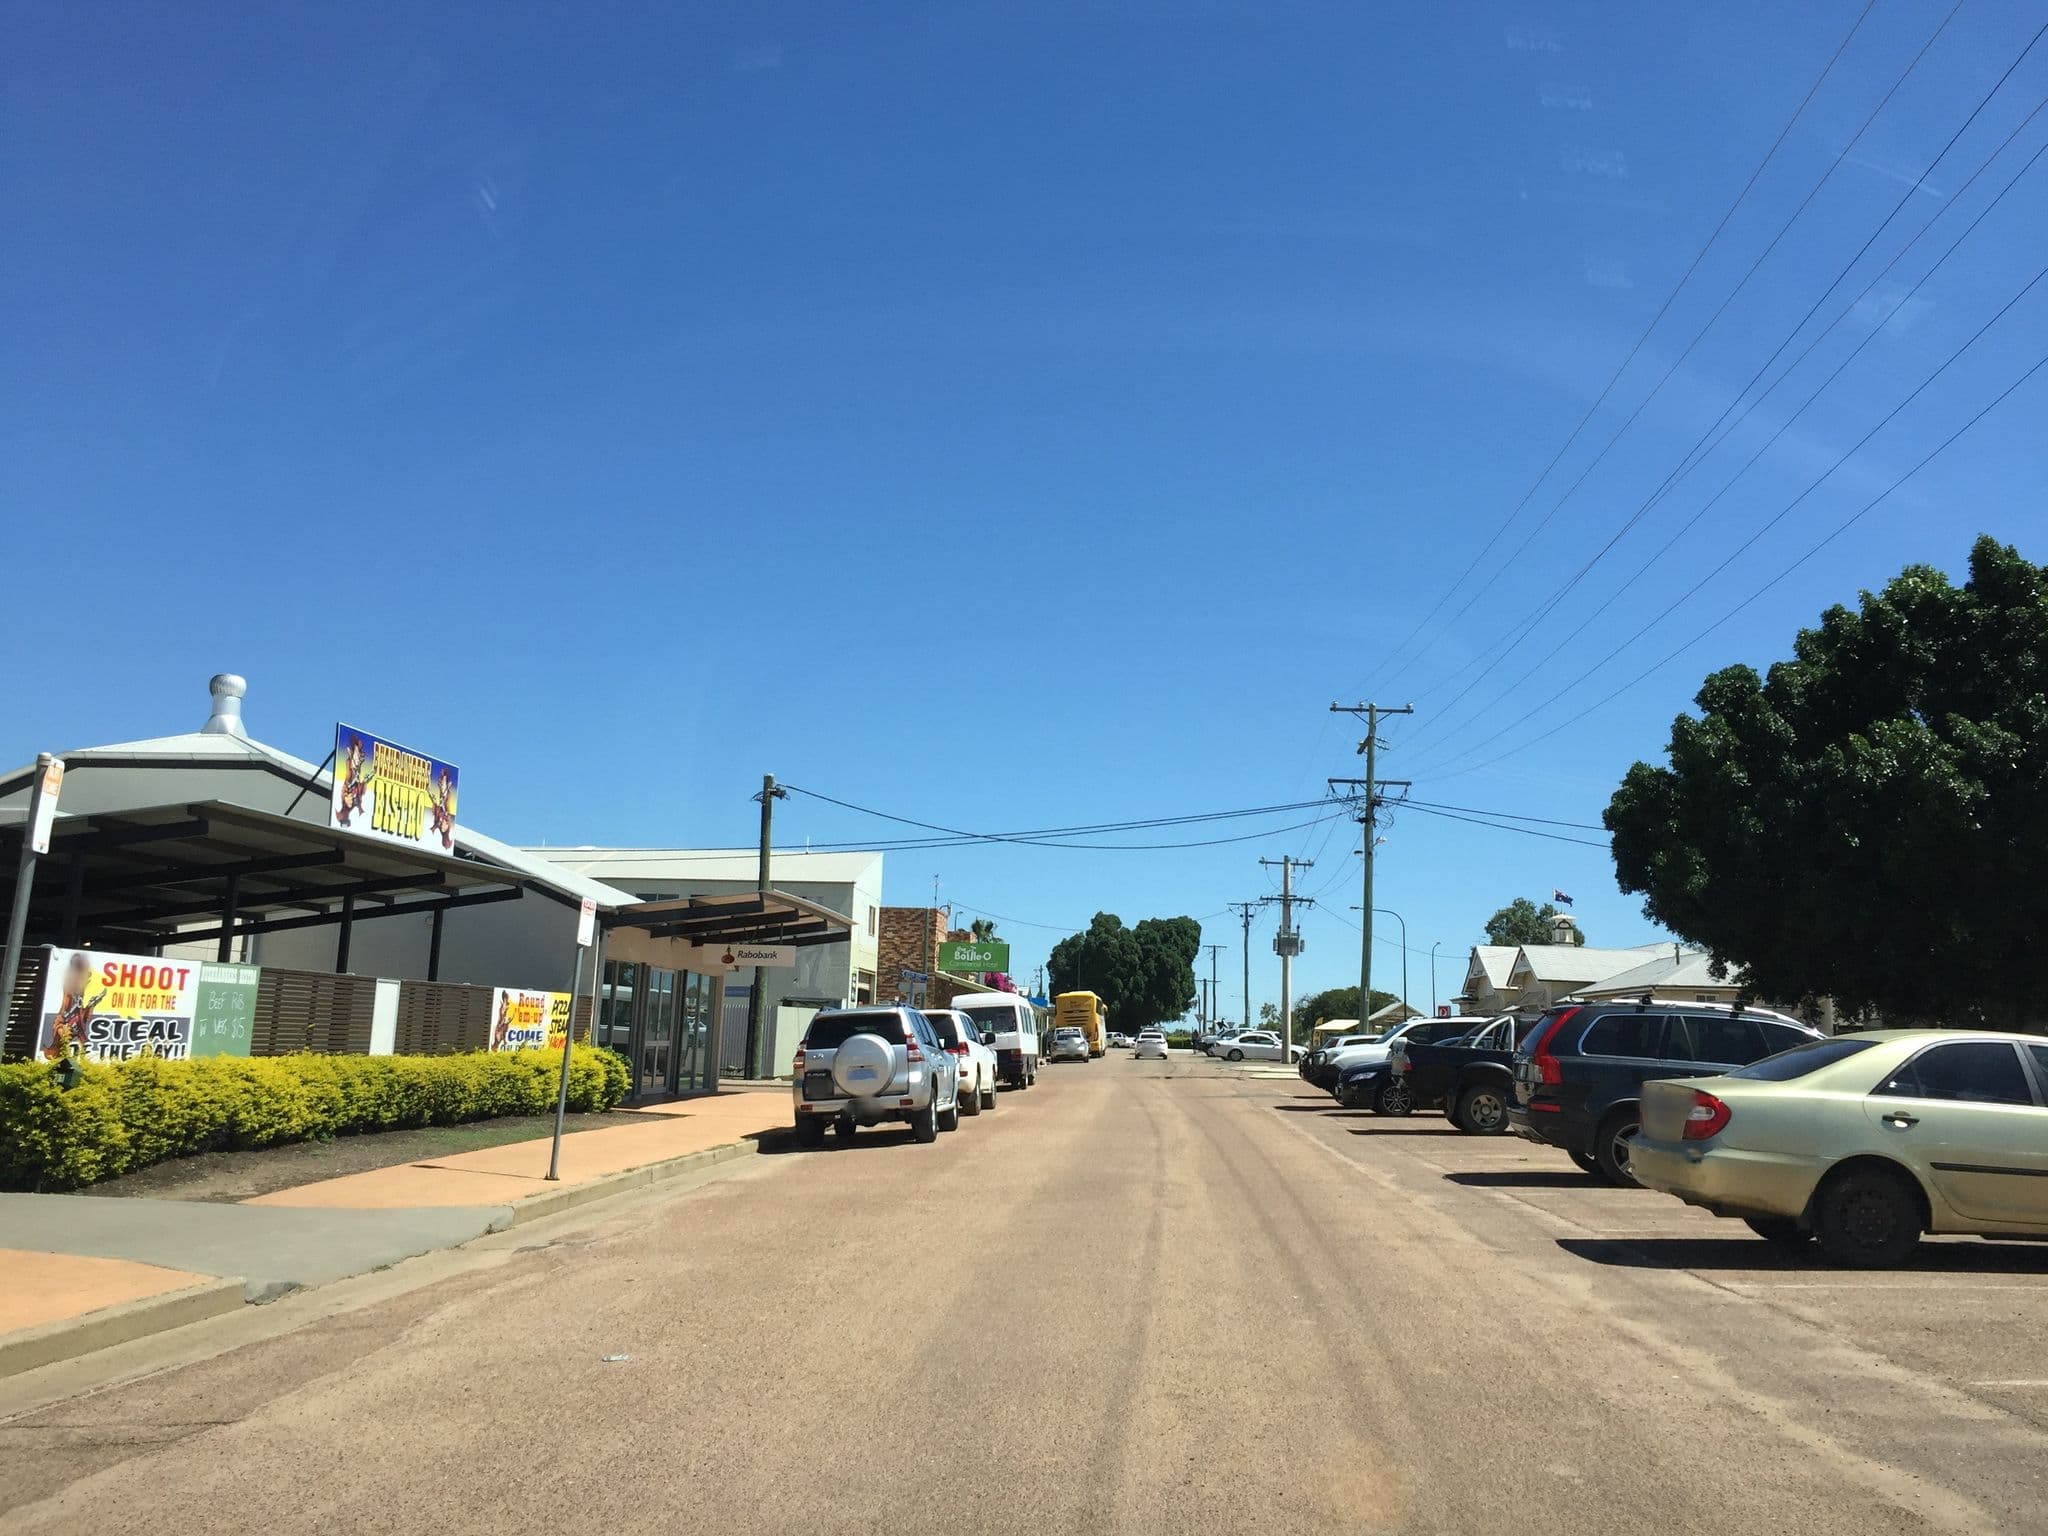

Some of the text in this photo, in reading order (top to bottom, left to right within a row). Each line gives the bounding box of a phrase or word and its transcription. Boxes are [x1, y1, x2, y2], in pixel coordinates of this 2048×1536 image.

[372, 779, 425, 841] BISTRO
[737, 950, 778, 959] Rabobank
[101, 962, 190, 991] SHOOT
[111, 992, 177, 1010] ON IN FOR THE
[519, 992, 545, 1009] Round
[90, 1018, 182, 1042] STEAL
[507, 1029, 544, 1042] COME
[99, 1044, 134, 1061] THE
